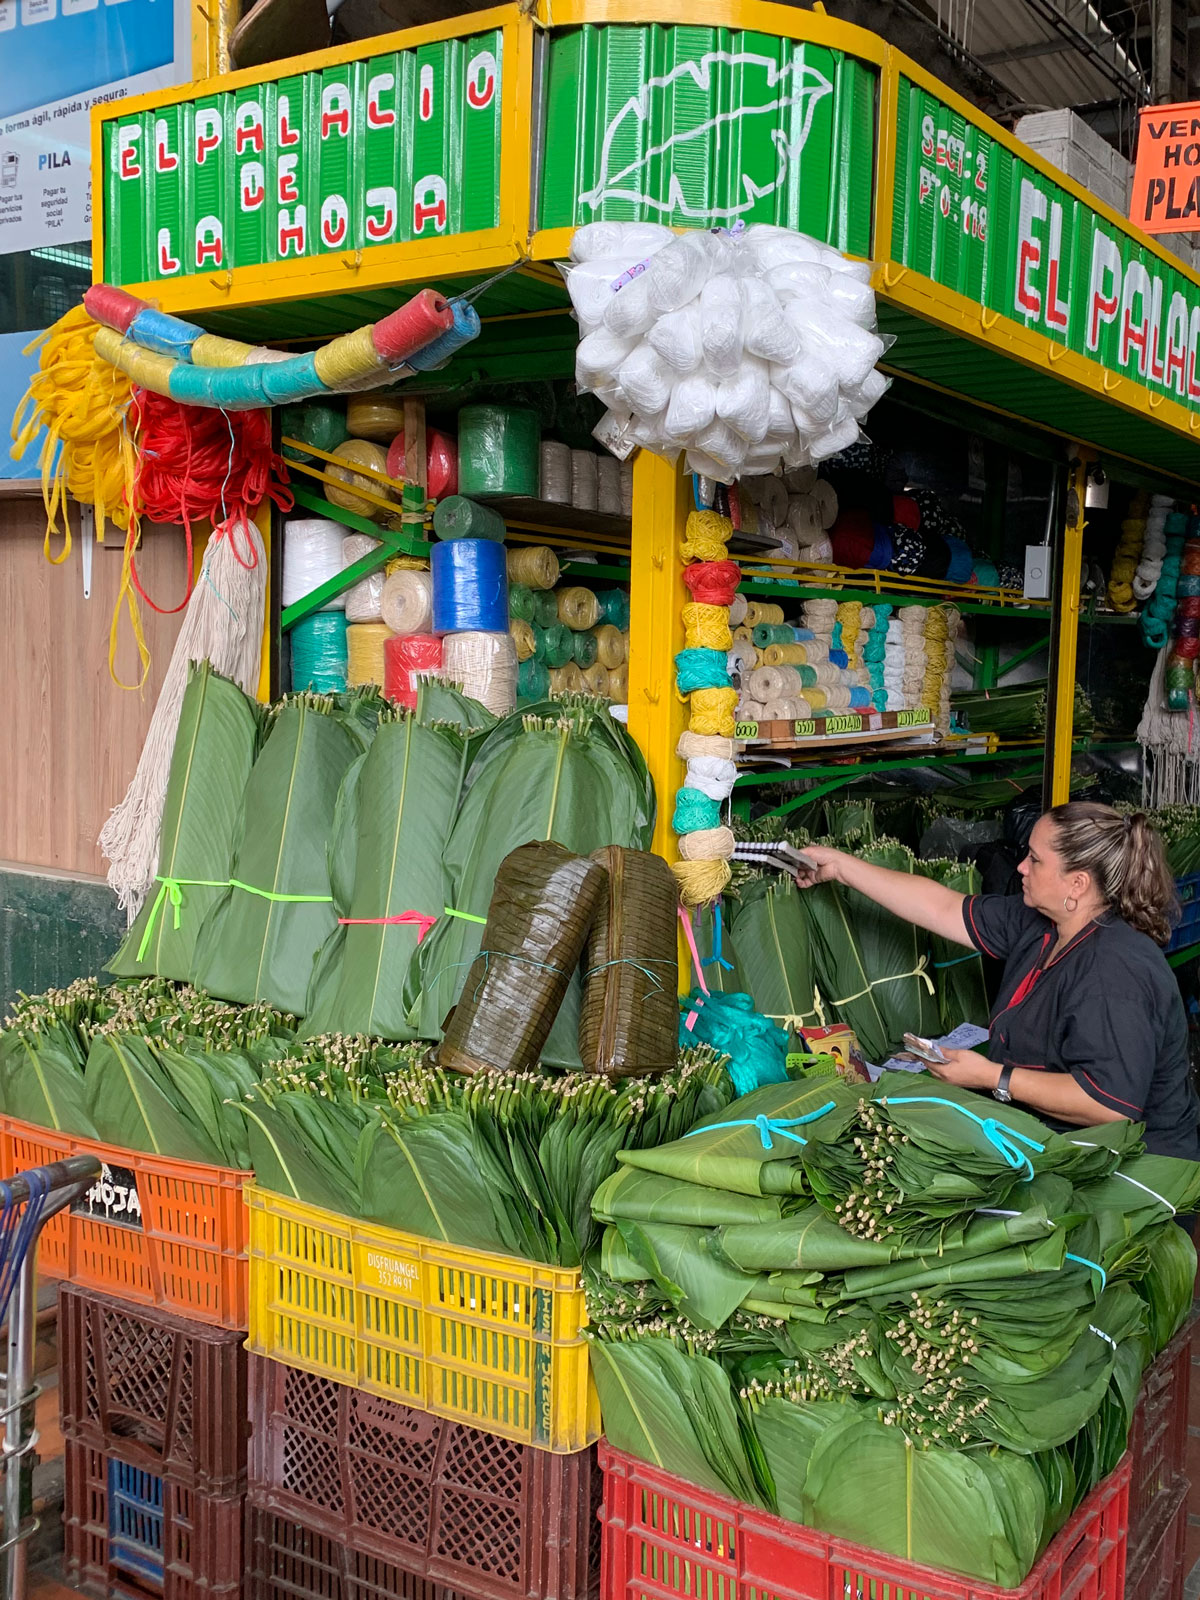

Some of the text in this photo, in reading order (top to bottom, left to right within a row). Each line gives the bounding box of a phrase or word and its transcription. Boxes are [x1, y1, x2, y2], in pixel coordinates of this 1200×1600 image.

[5, 119, 30, 133] forma
[53, 102, 82, 118] rápida
[84, 100, 91, 111] y
[92, 88, 128, 105] segura:
[38, 150, 71, 170] PILA
[1164, 143, 1200, 168] HO
[41, 197, 68, 208] seguridad
[43, 188, 59, 198] Pagar
[1144, 175, 1200, 221] PLA
[46, 208, 63, 218] social
[158, 174, 448, 275] LA HOJA
[1014, 177, 1069, 334] EL
[735, 721, 757, 737] 6000
[367, 1252, 420, 1280] DISFRUANGEL
[378, 1269, 392, 1287] 352
